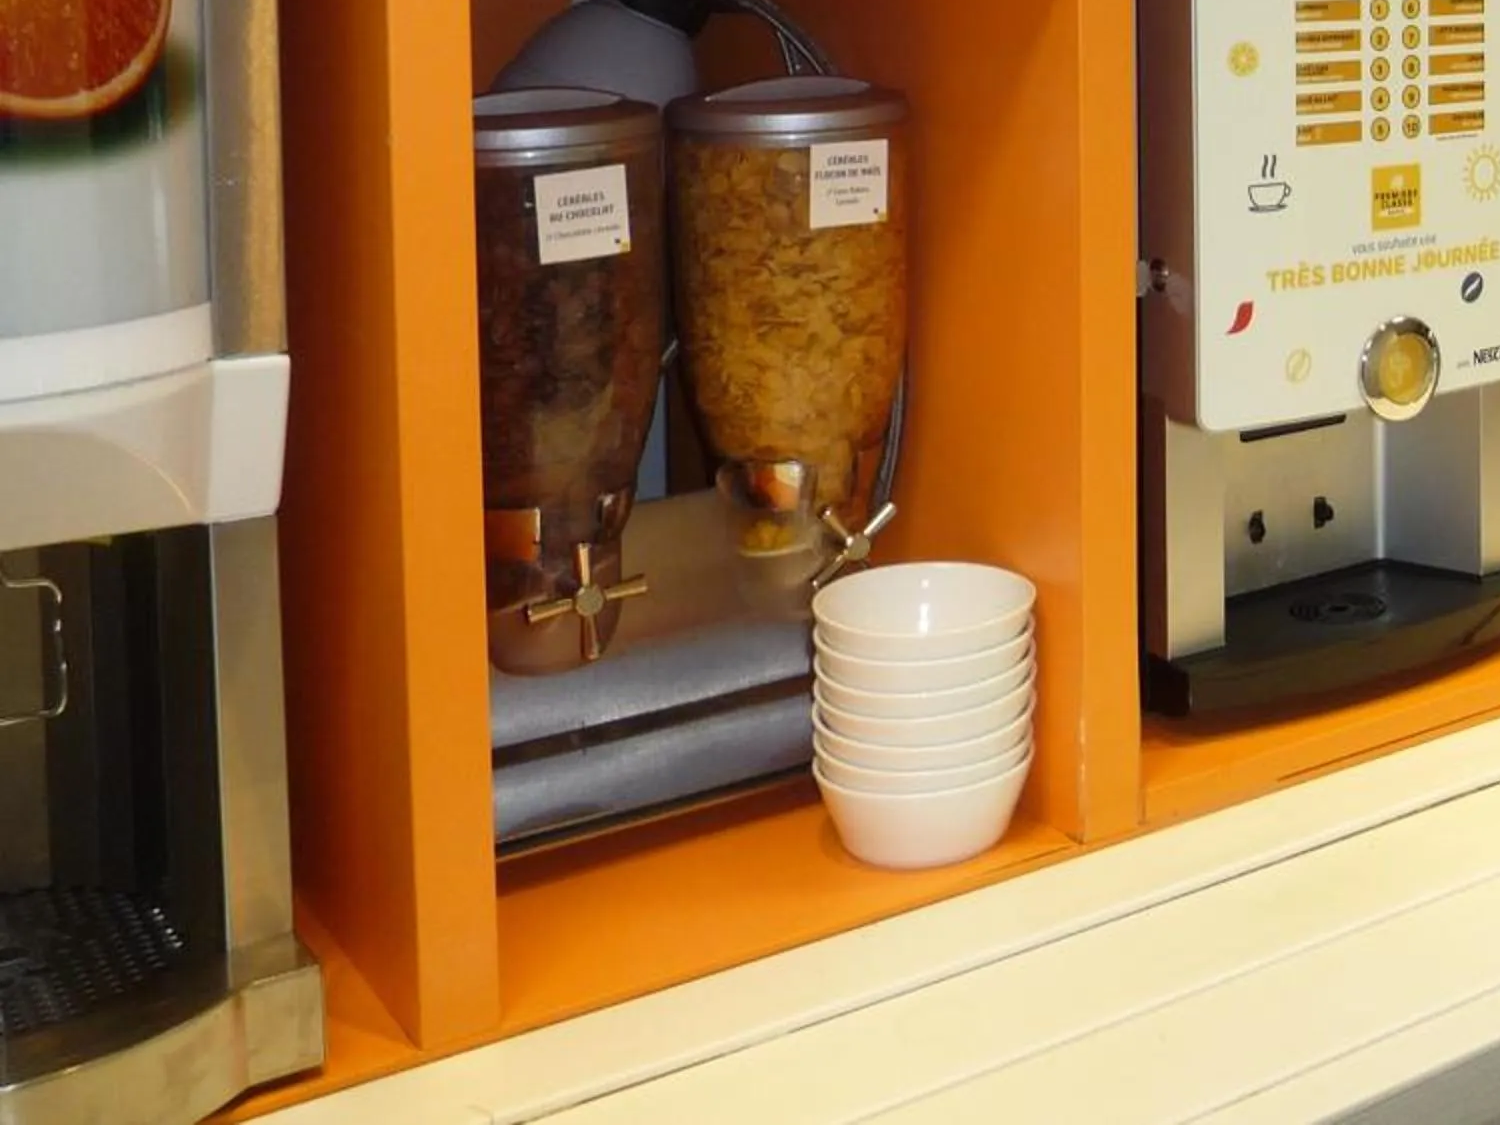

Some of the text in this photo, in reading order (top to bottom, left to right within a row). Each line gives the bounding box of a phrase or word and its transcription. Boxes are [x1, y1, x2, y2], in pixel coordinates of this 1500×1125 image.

[1266, 260, 1326, 292] TRÈS
[1331, 255, 1407, 284] BONNE
[1413, 235, 1500, 272] JOURNÉE
